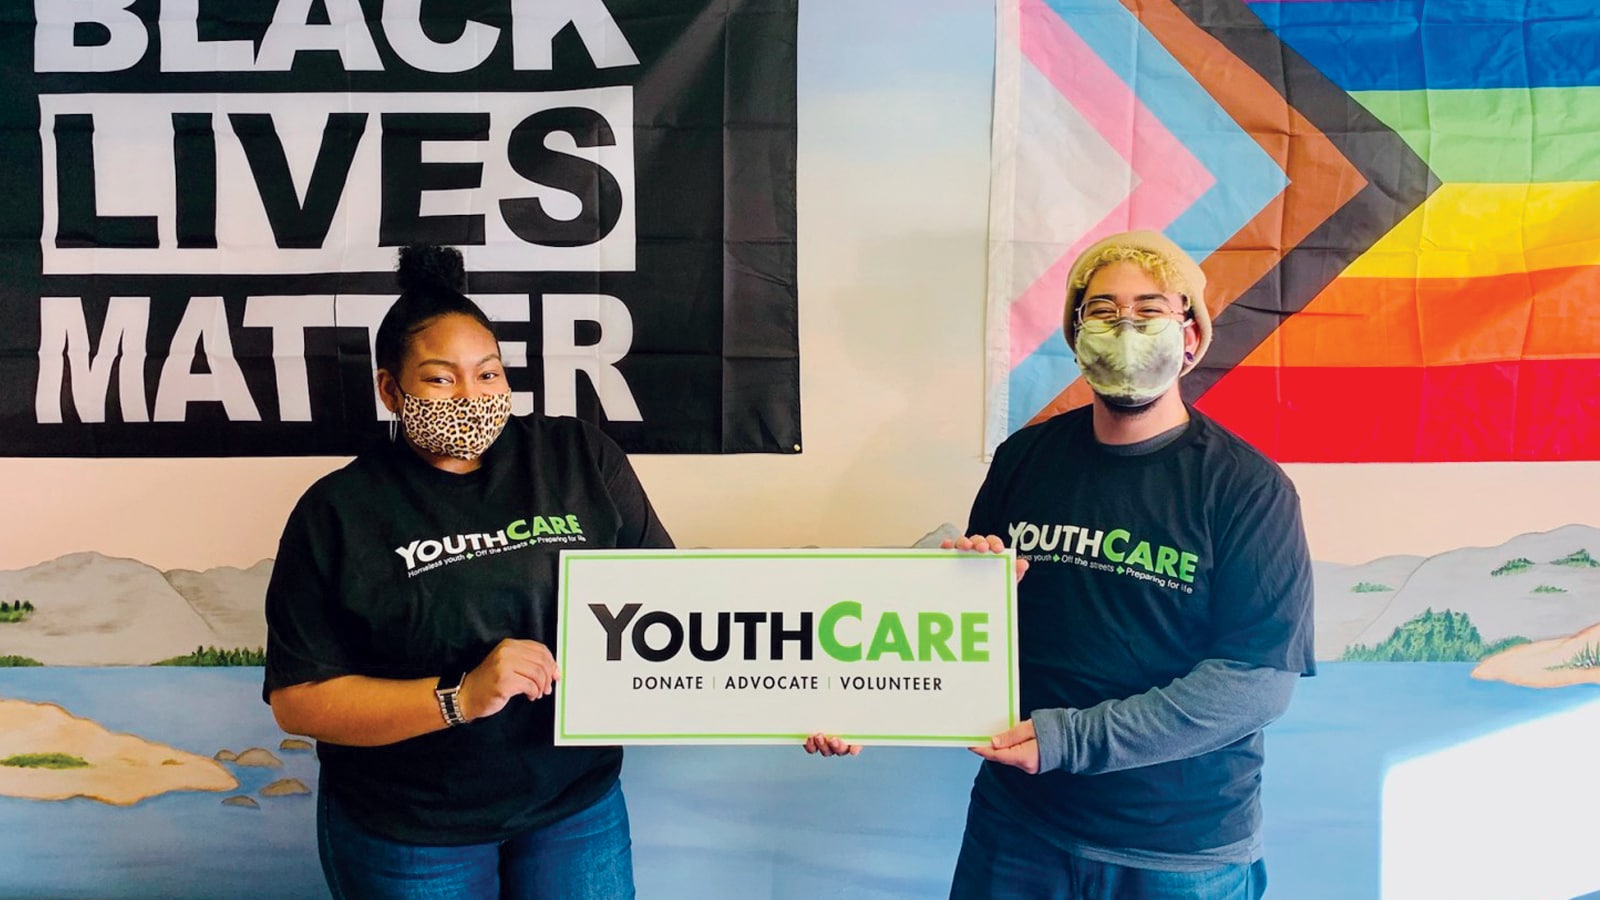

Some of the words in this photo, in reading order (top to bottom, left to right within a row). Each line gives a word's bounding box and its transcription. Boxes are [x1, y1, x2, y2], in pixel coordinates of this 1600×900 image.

[34, 0, 640, 73] BLACK
[54, 107, 623, 249] LIVES
[395, 514, 583, 570] YOUTHCARE
[408, 560, 443, 578] Homeless
[443, 554, 465, 565] youth
[475, 550, 488, 558] Off
[489, 547, 501, 555] the
[503, 541, 529, 552] streets
[537, 536, 568, 545] Preparing
[567, 535, 576, 543] for
[1033, 554, 1052, 562] youth
[1061, 554, 1073, 563] Off
[1074, 557, 1088, 567] the
[1090, 561, 1115, 573] streets
[1125, 567, 1166, 587] Preparing
[1167, 579, 1180, 590] for
[587, 600, 990, 662] YOUTHCARE
[632, 675, 703, 691] DONATE
[725, 675, 819, 691] ADVOCATE
[840, 675, 943, 692] VOLUNTEER
